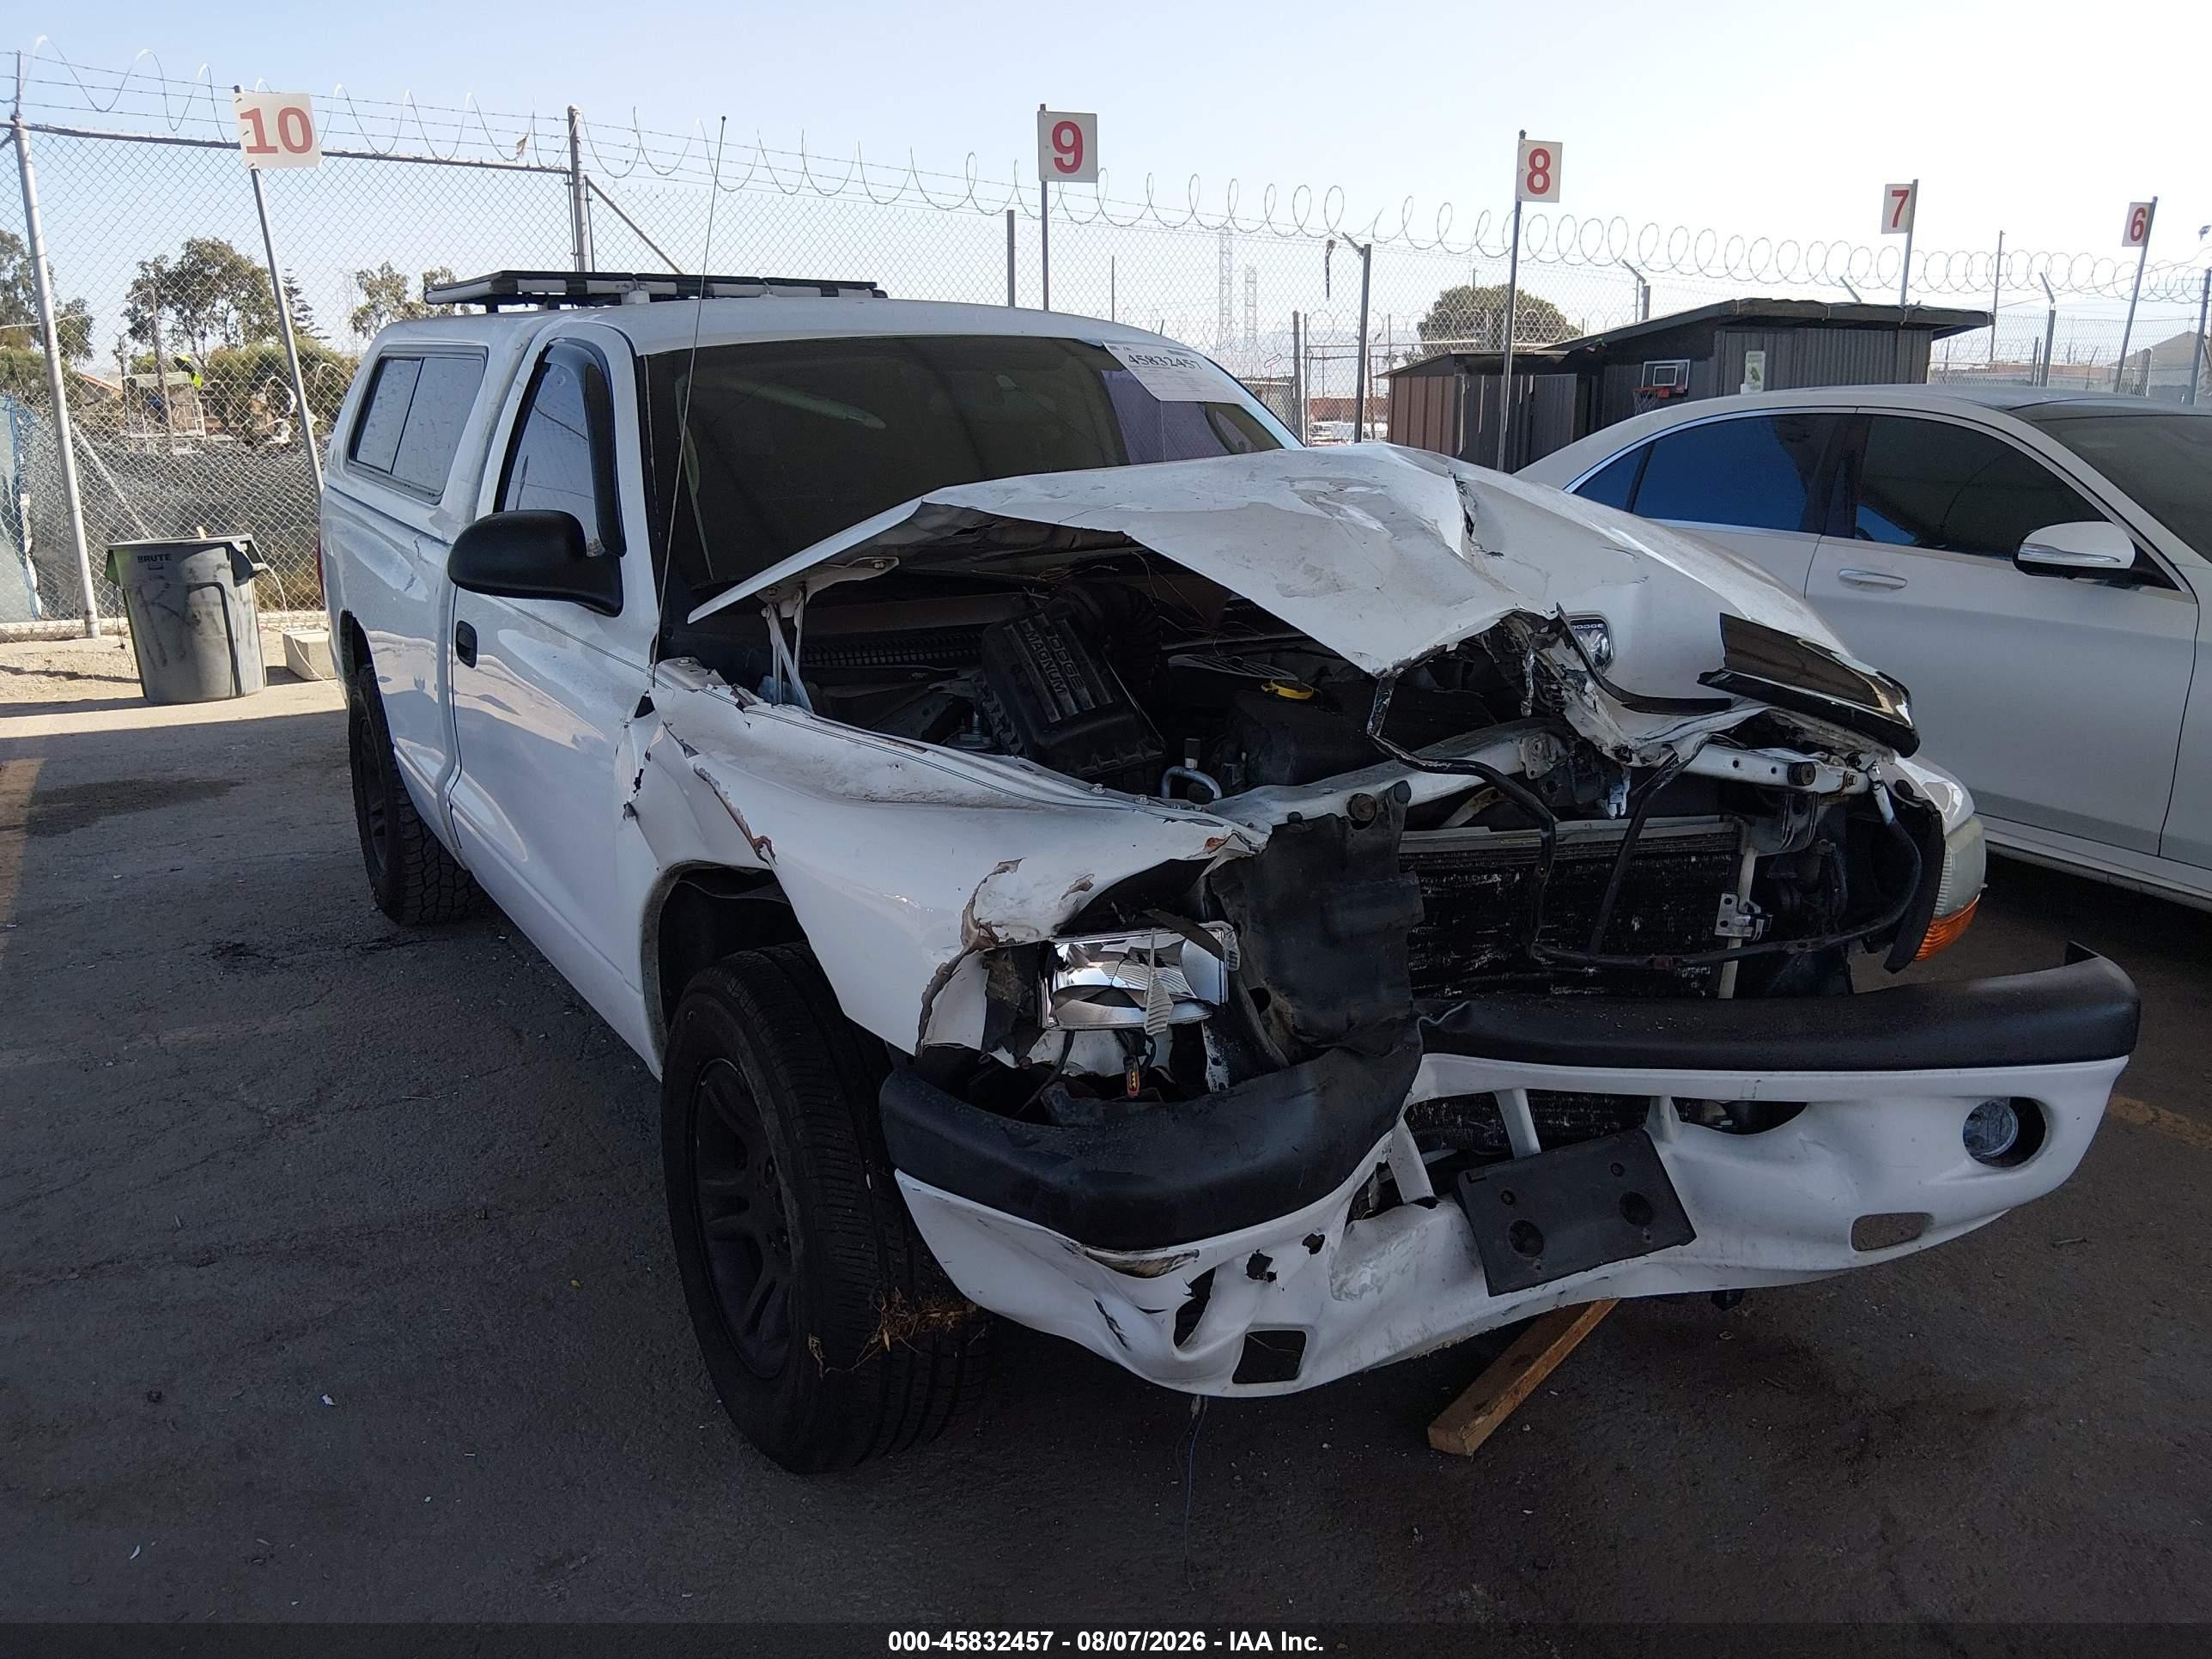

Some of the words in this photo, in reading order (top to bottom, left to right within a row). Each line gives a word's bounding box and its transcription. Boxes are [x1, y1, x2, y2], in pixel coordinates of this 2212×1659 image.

[240, 107, 313, 154] 10
[1052, 120, 1084, 174] 9
[1526, 149, 1551, 195] 8
[1892, 190, 1909, 228] 7
[2130, 207, 2146, 241] 6
[1128, 354, 1202, 370] 45832457
[137, 553, 172, 563] BRUTE
[1025, 630, 1067, 694] MAGNUM
